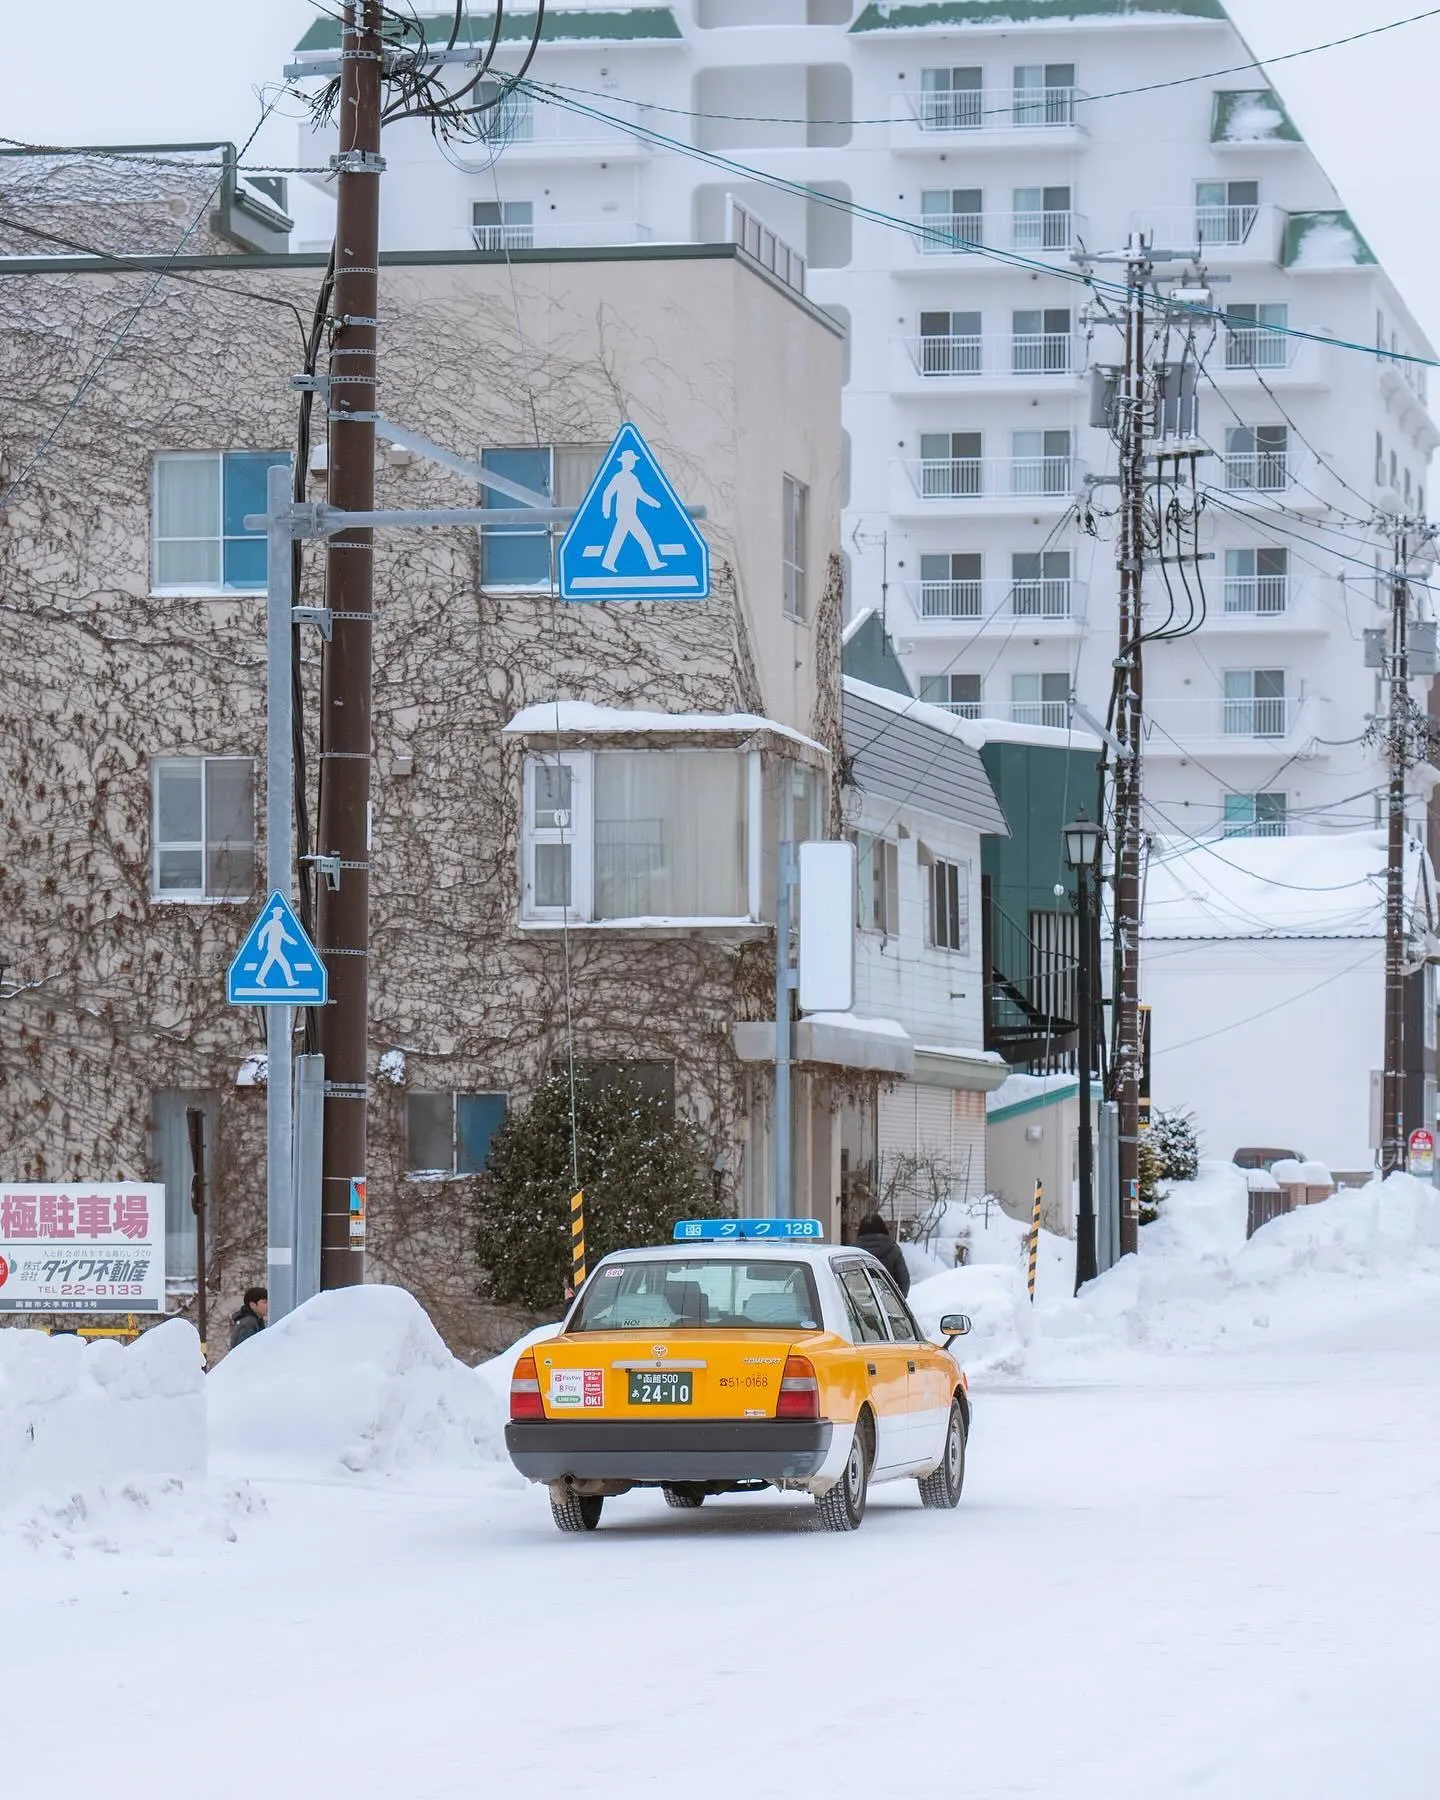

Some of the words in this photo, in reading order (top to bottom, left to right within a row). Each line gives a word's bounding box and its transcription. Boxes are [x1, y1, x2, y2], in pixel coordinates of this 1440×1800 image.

[1, 1194, 149, 1239] 極駐車場
[784, 1223, 813, 1235] 128
[41, 1259, 150, 1282] ダイワ不動産
[38, 1286, 58, 1294] TEL
[61, 1284, 142, 1295] 22-8133
[728, 1377, 768, 1388] 51-0168
[632, 1389, 640, 1398] あ
[641, 1385, 689, 1402] 24-10
[585, 1396, 601, 1405] OK!
